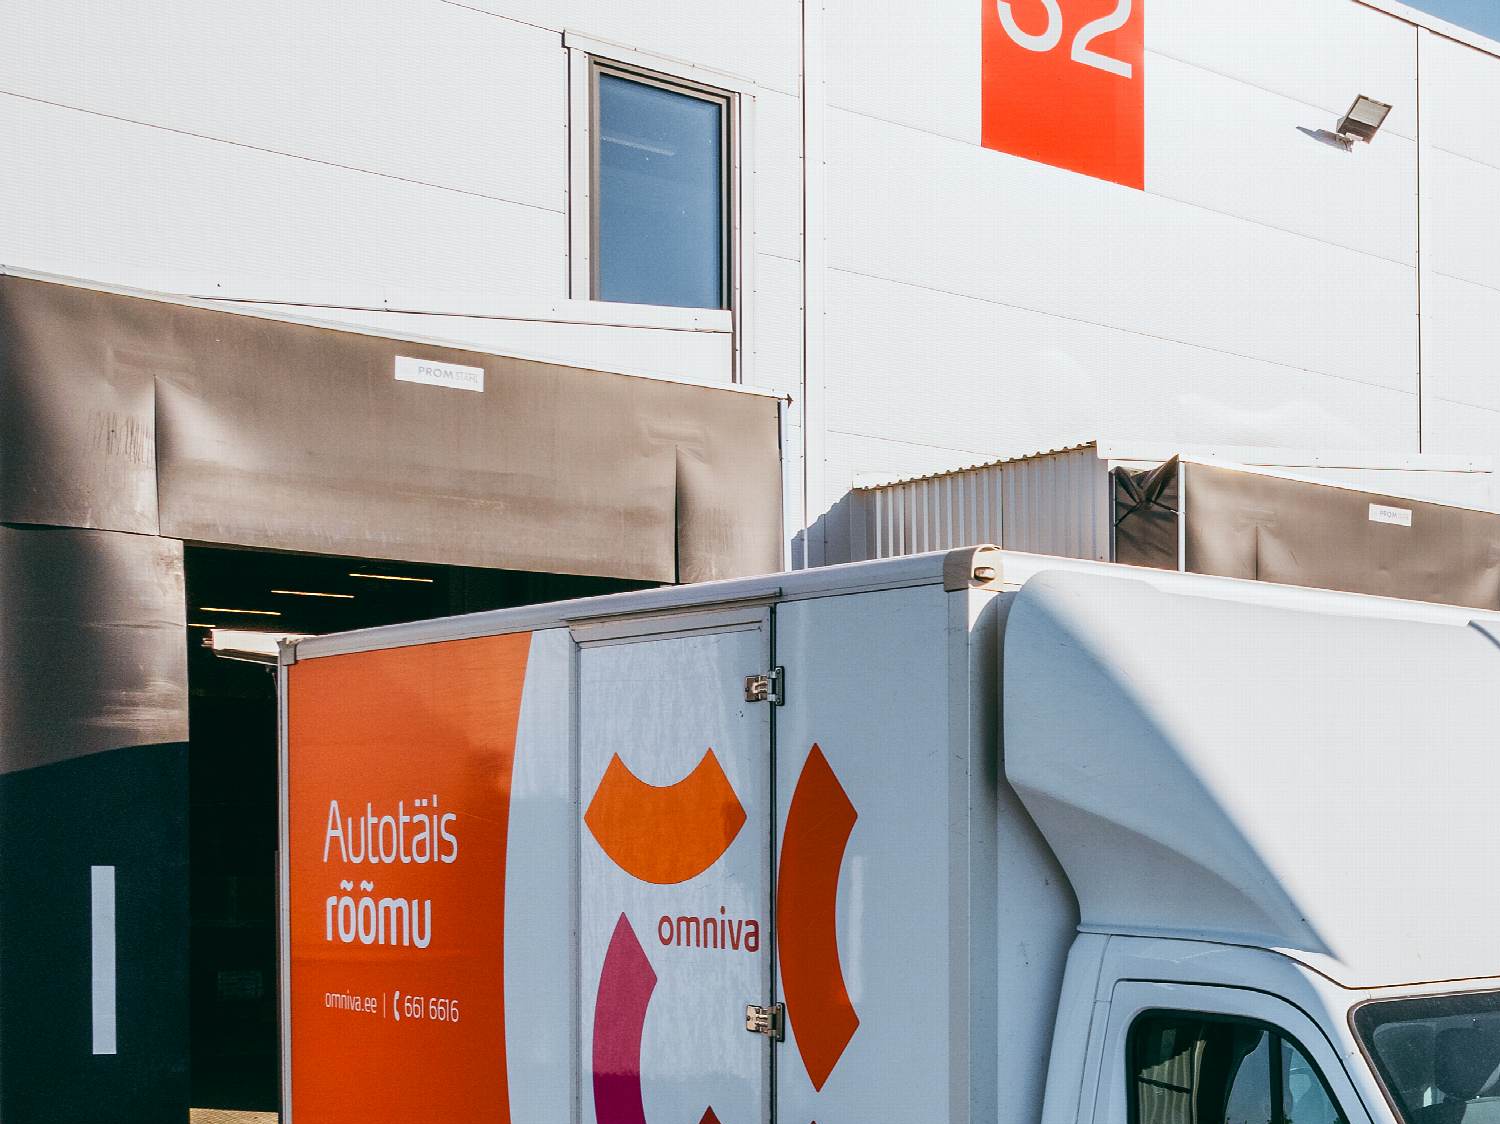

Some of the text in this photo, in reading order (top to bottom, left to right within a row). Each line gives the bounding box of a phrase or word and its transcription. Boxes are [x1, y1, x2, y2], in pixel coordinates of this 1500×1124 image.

[323, 794, 458, 864] Autotäis
[326, 880, 432, 949] rõõmu
[658, 905, 760, 953] omniva
[325, 989, 459, 1022] omniva.ee 661 6616
